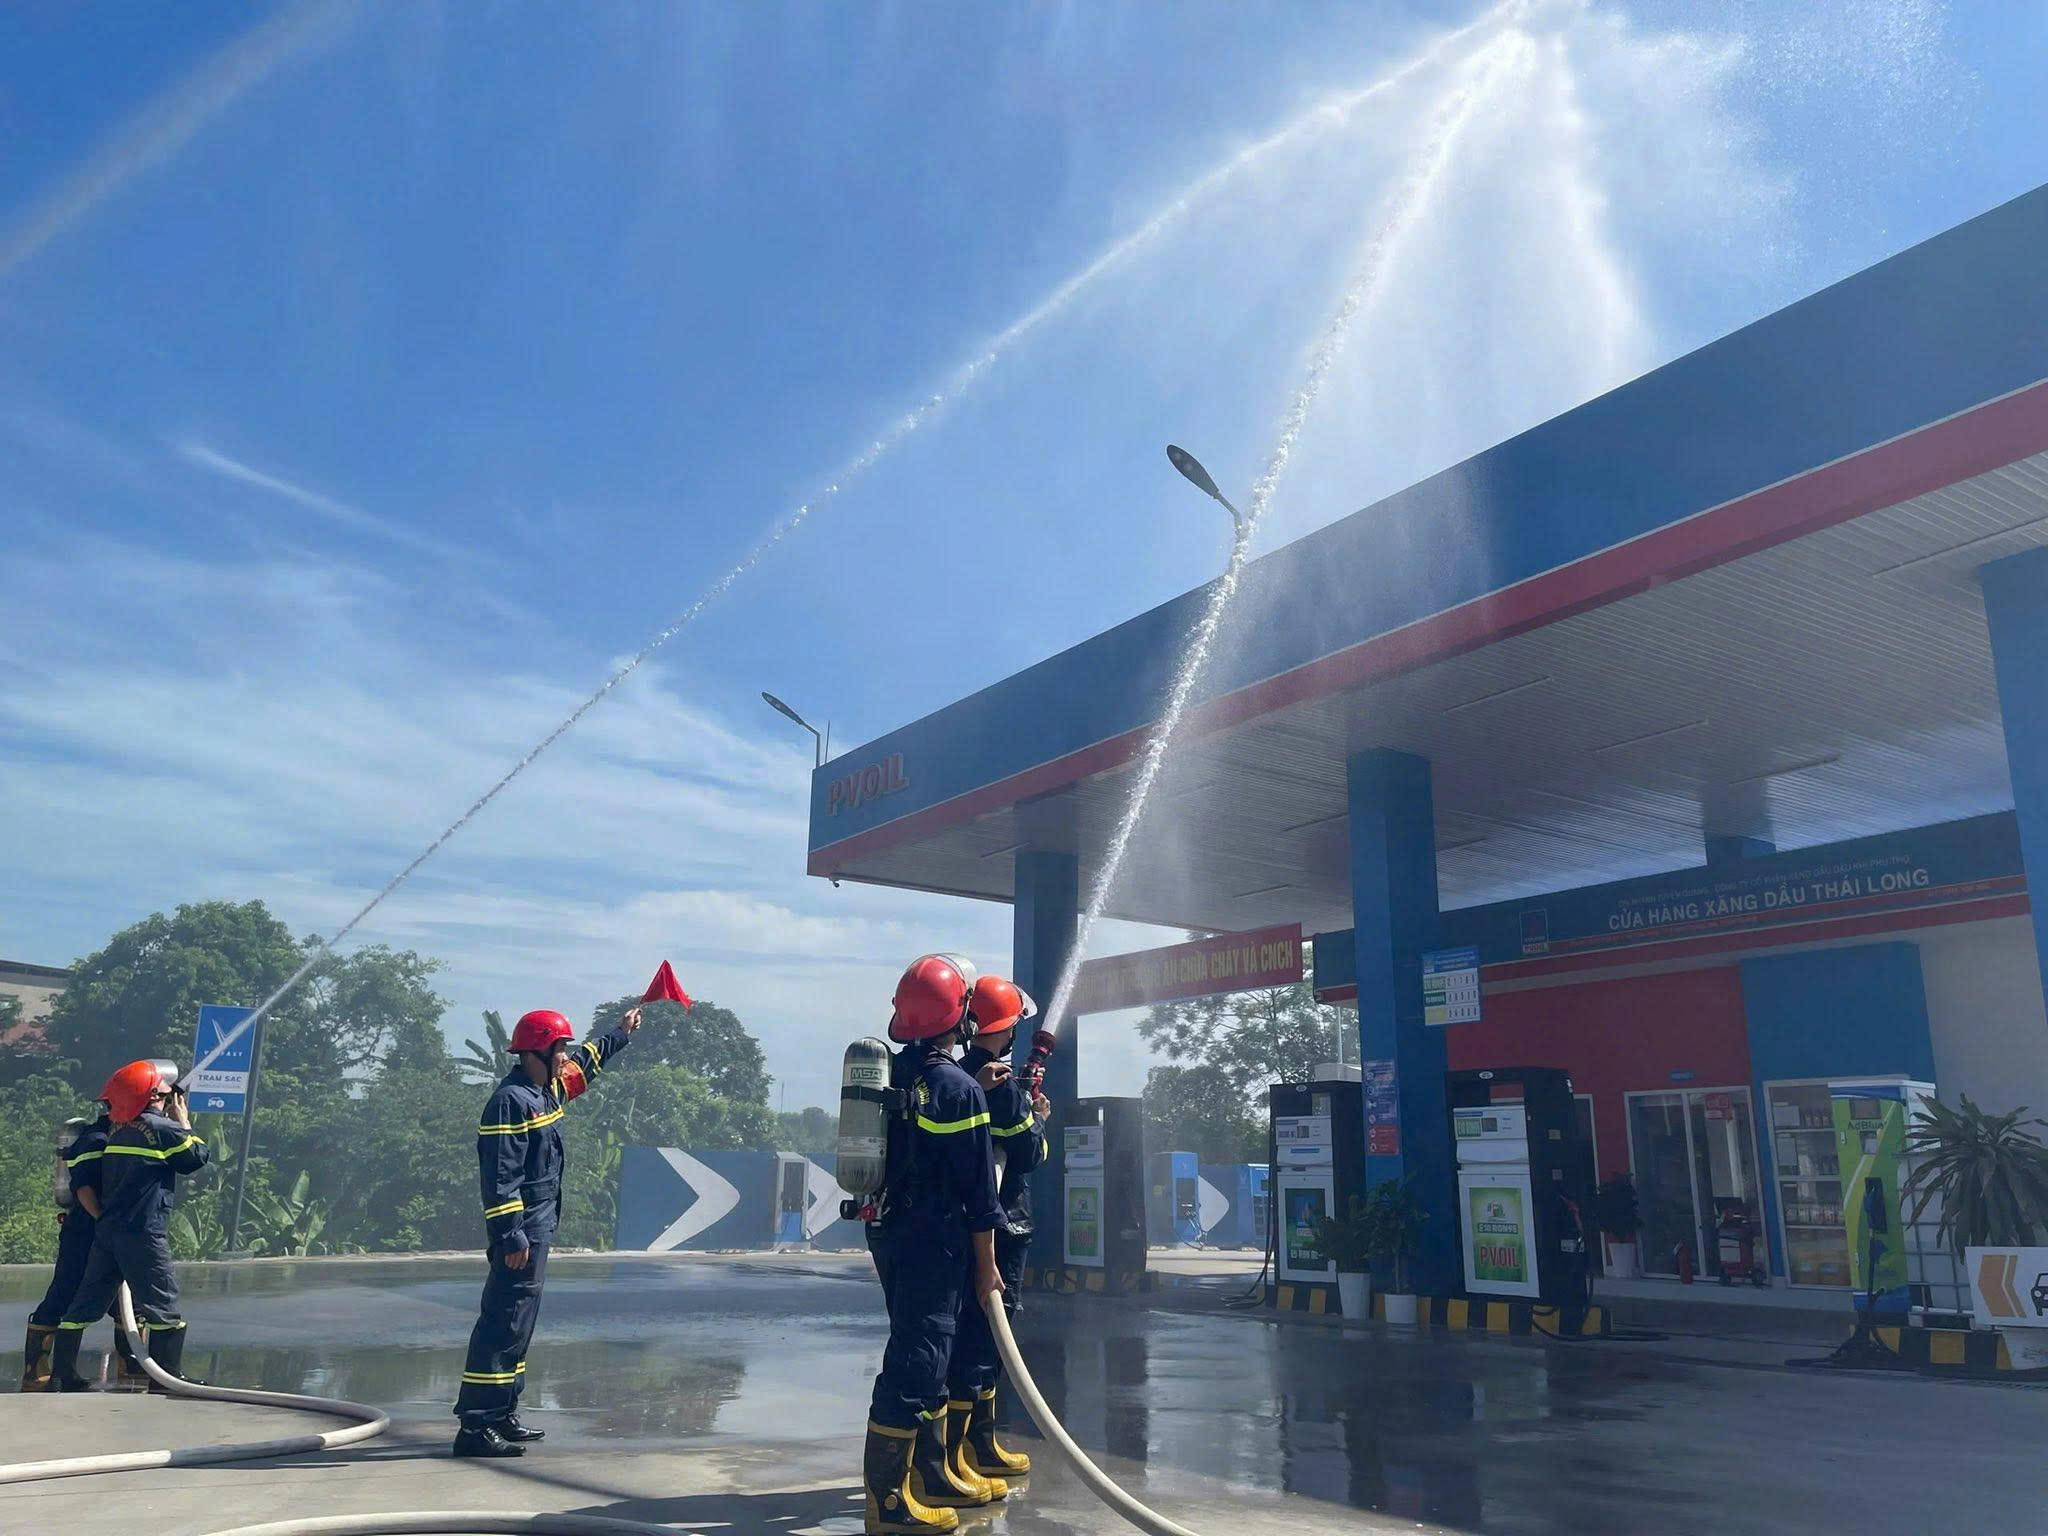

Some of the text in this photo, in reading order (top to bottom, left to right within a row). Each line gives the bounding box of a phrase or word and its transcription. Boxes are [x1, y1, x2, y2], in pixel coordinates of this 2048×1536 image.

[825, 752, 911, 816] PVOIL
[1608, 905, 1645, 930] CỬA
[1649, 902, 1699, 925] HÀNG
[1705, 893, 1757, 917] XĂNG
[1764, 881, 1807, 907] DẦU
[1811, 876, 1861, 900] THÁI
[1867, 868, 1929, 893] LONG
[1260, 940, 1294, 972] CNCH
[851, 1068, 881, 1080] MSA
[1480, 1245, 1520, 1268] PVOIL
